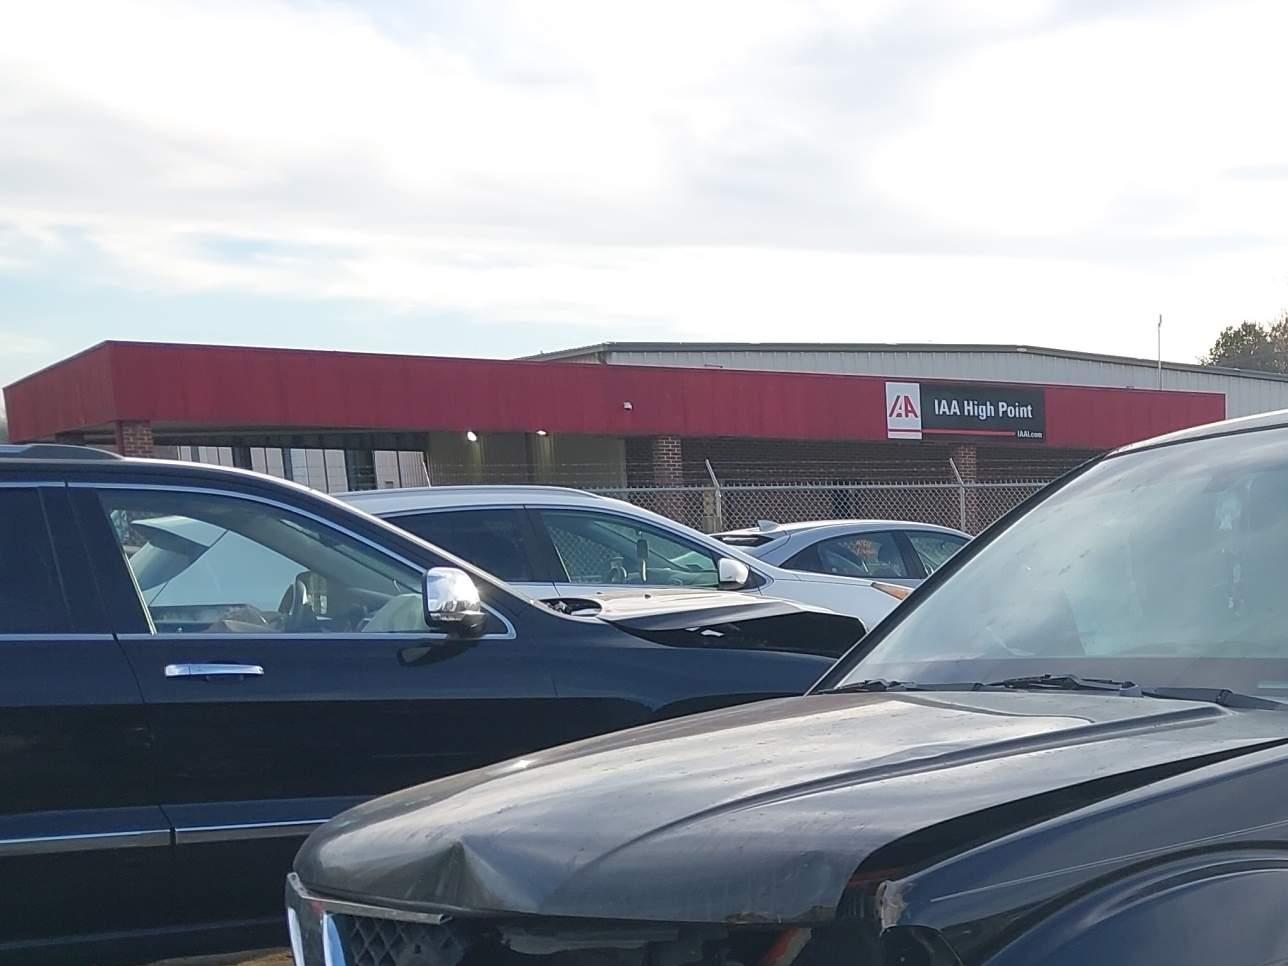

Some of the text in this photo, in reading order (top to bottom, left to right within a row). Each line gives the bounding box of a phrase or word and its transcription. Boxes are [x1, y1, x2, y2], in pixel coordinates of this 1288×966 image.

[934, 399, 1033, 420] IAA High Point
